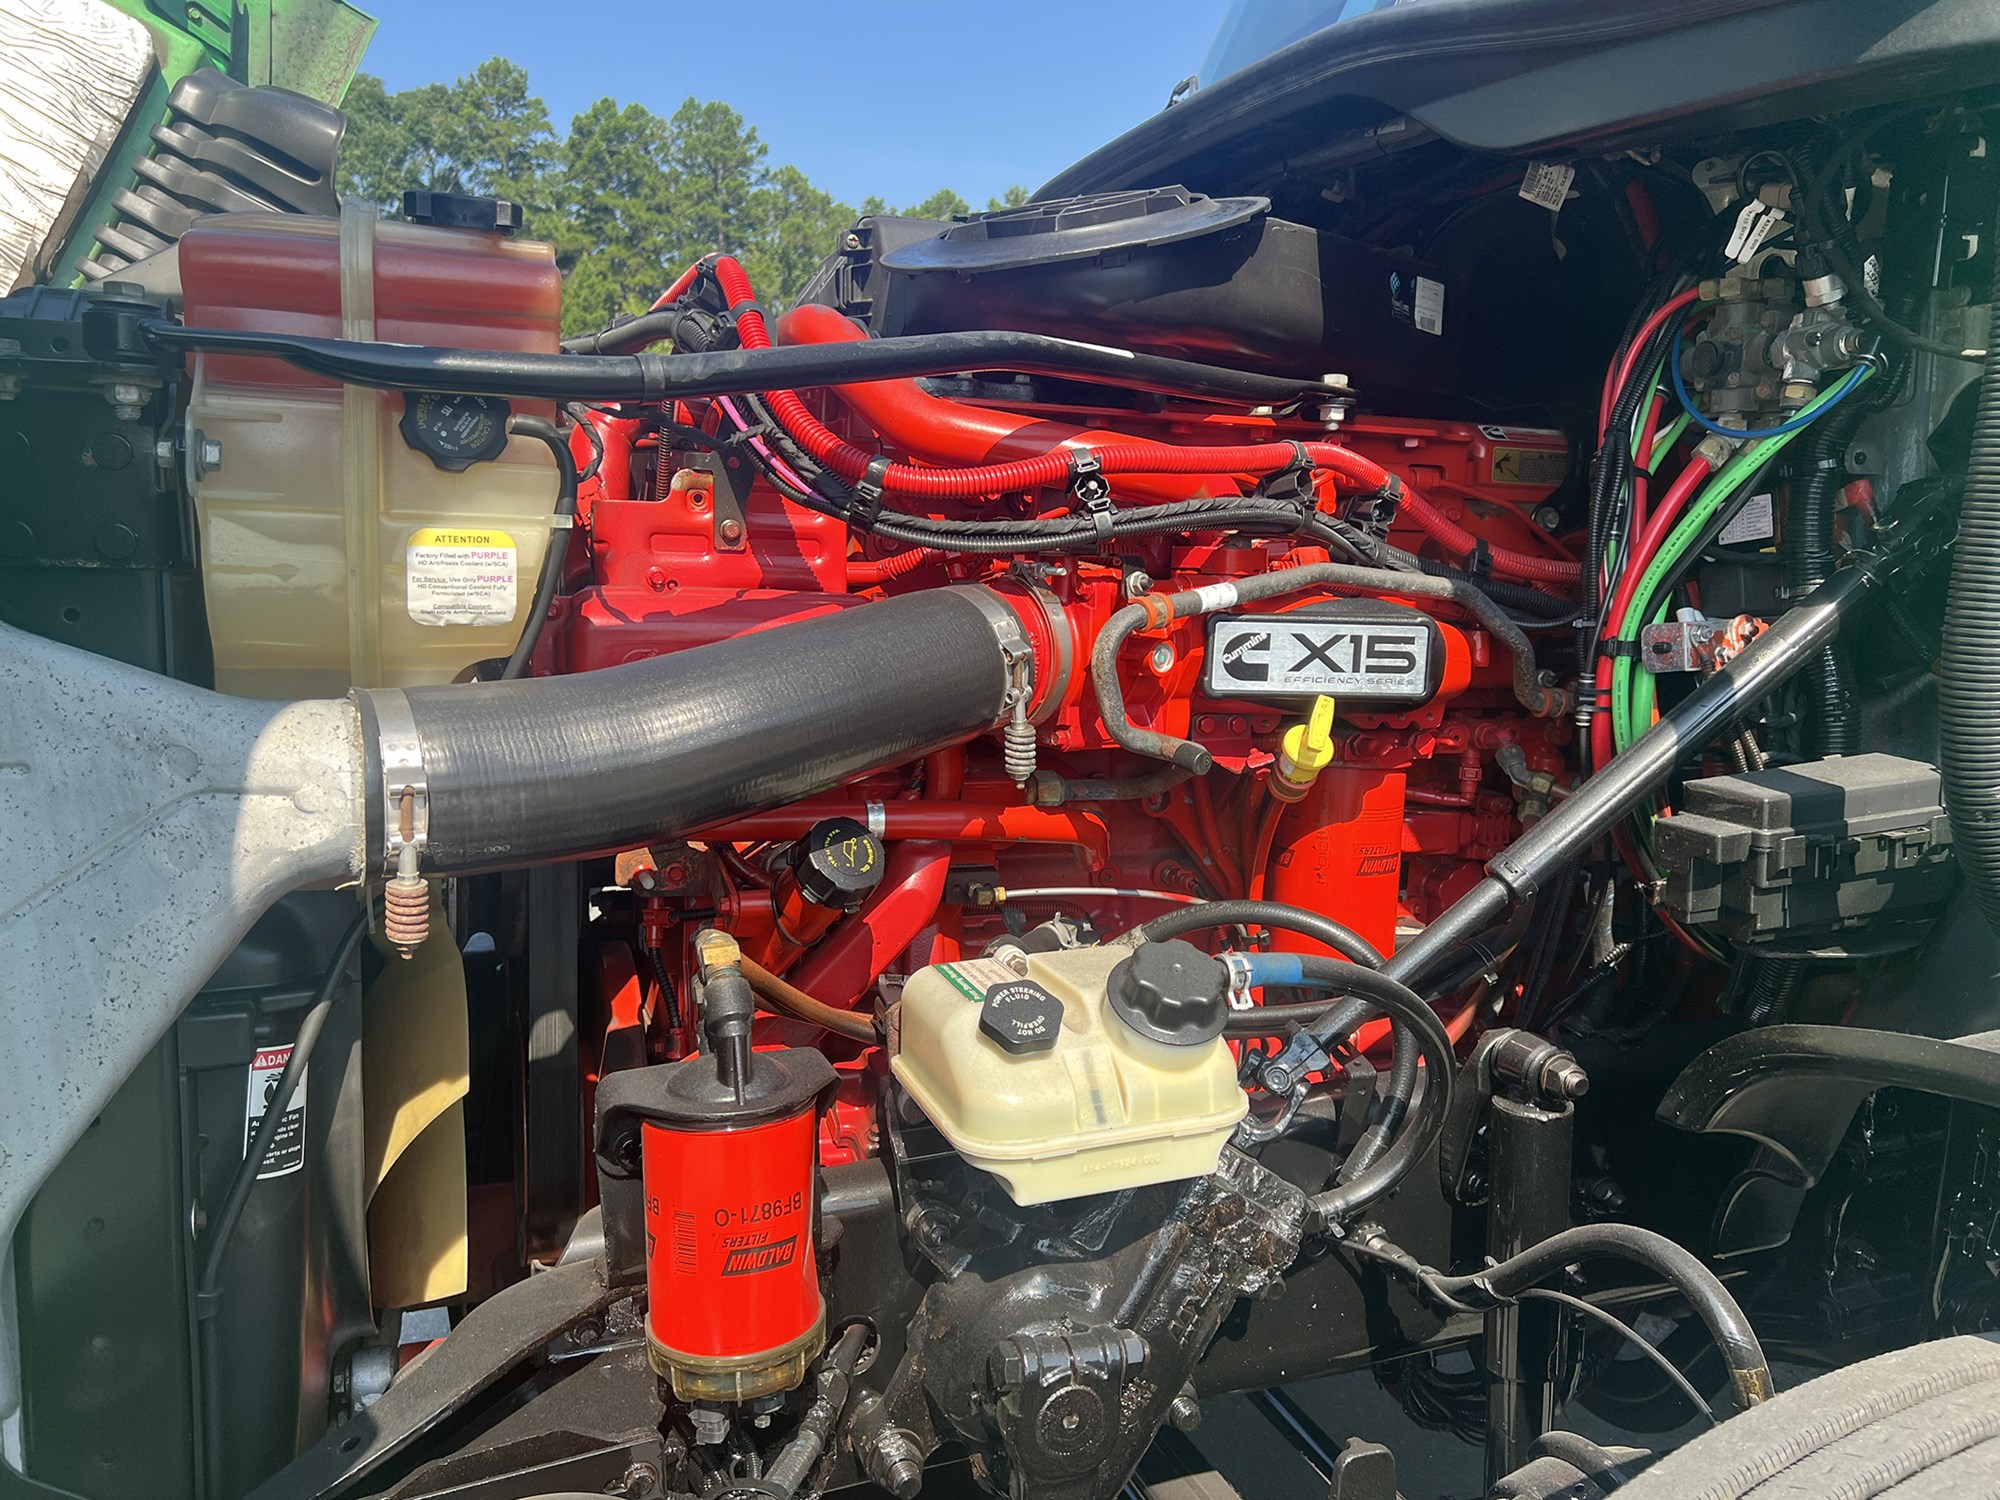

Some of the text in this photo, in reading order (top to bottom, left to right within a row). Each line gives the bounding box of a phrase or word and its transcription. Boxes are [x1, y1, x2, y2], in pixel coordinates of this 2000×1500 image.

[470, 425, 490, 448] CAUTION
[435, 535, 490, 543] ATTENTION
[477, 575, 513, 583] PURPLE
[1287, 632, 1417, 674] X15
[1284, 676, 1415, 686] EFFICIENCY SERIES
[863, 839, 874, 864] ENGINE
[1360, 846, 1388, 855] FILTERS
[992, 987, 1046, 1008] POWER STEERING
[1006, 994, 1030, 1003] FLUID
[1012, 1015, 1045, 1029] OVERFILL
[1017, 1026, 1046, 1036] DO NOT
[268, 1052, 291, 1066] DAN
[289, 1113, 299, 1121] Fan
[722, 1232, 769, 1248] FILTERS
[727, 1242, 794, 1272] BALDWIN
